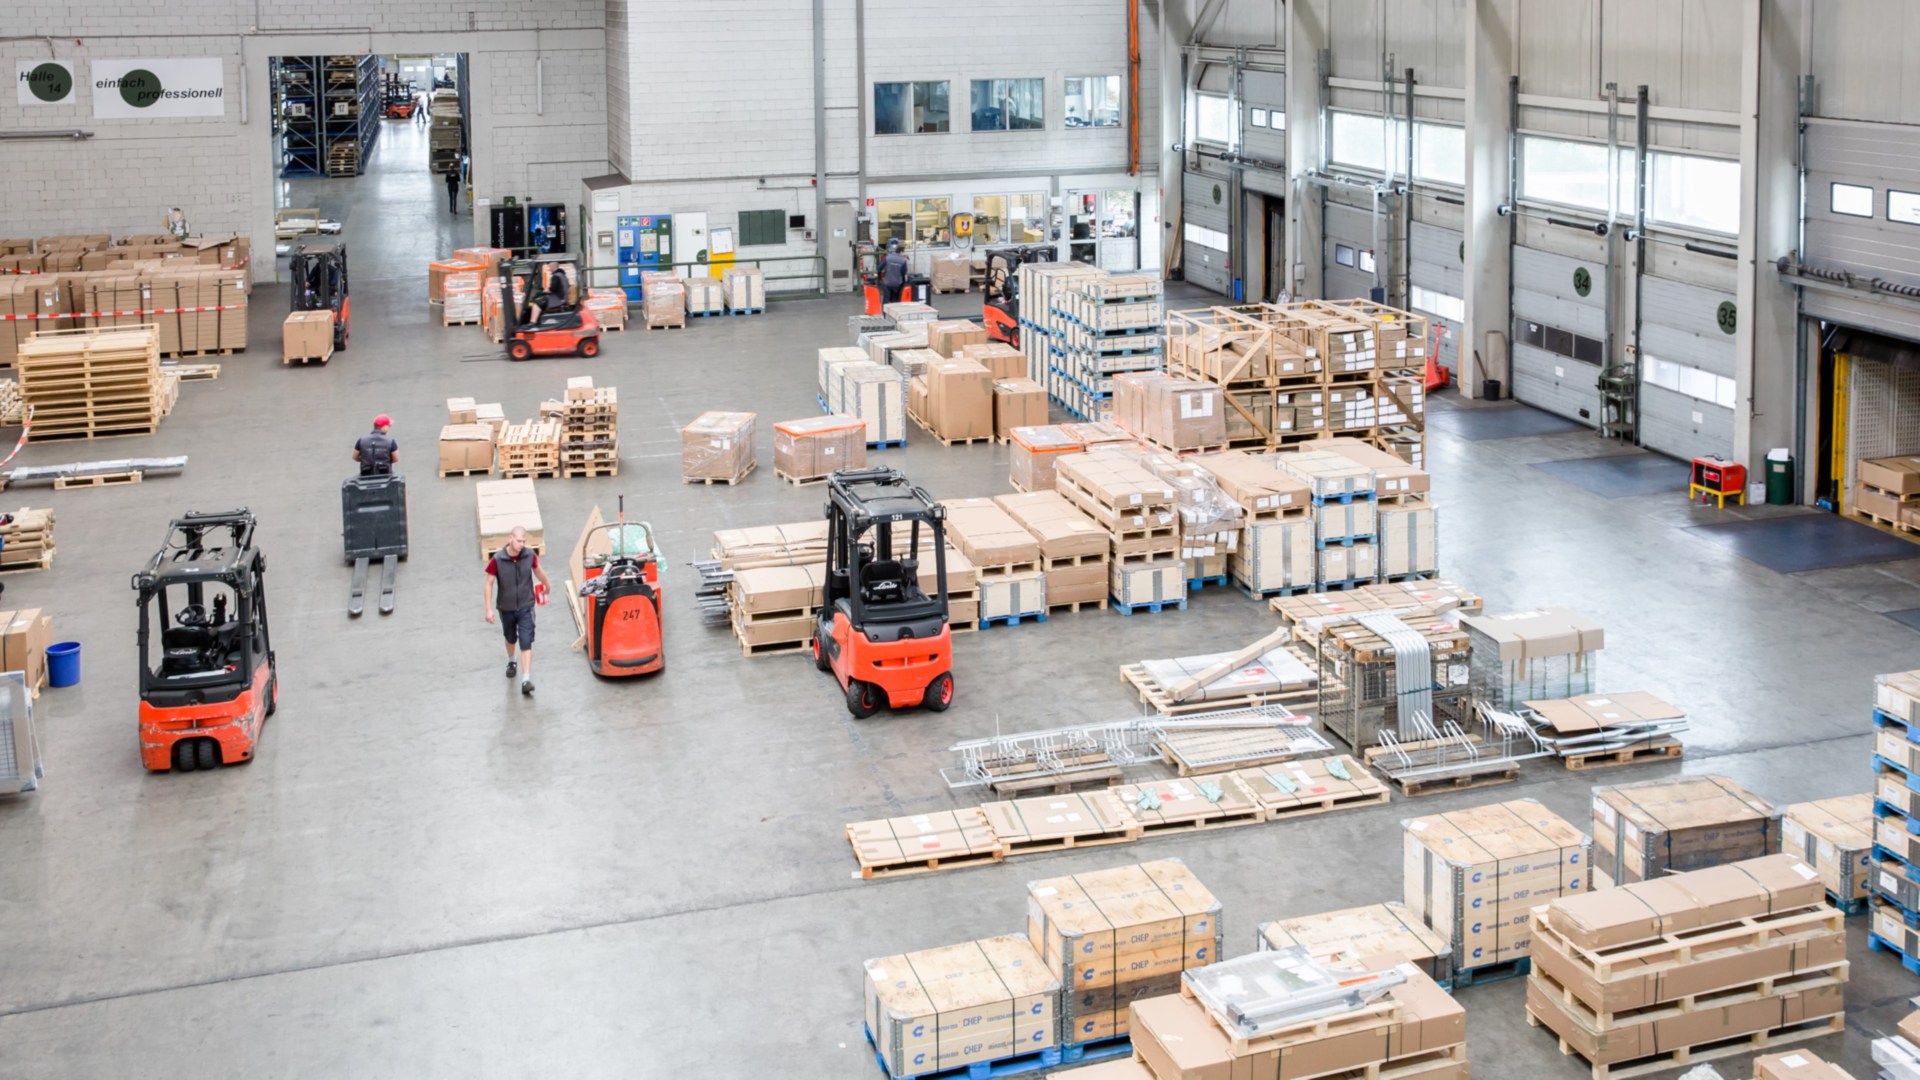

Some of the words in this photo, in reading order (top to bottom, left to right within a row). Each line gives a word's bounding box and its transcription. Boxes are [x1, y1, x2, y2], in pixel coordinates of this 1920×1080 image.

[19, 71, 55, 82] Halle
[47, 83, 61, 94] 14
[96, 77, 145, 89] einfach
[137, 87, 223, 102] professionell
[338, 104, 345, 112] 17
[1573, 272, 1590, 291] 34
[1718, 307, 1737, 328] 35
[622, 609, 640, 620] 247
[1131, 933, 1149, 944] CHEP
[1131, 959, 1149, 971] CHEP
[962, 1016, 983, 1027] CHEP
[963, 1043, 983, 1055] CHEP
